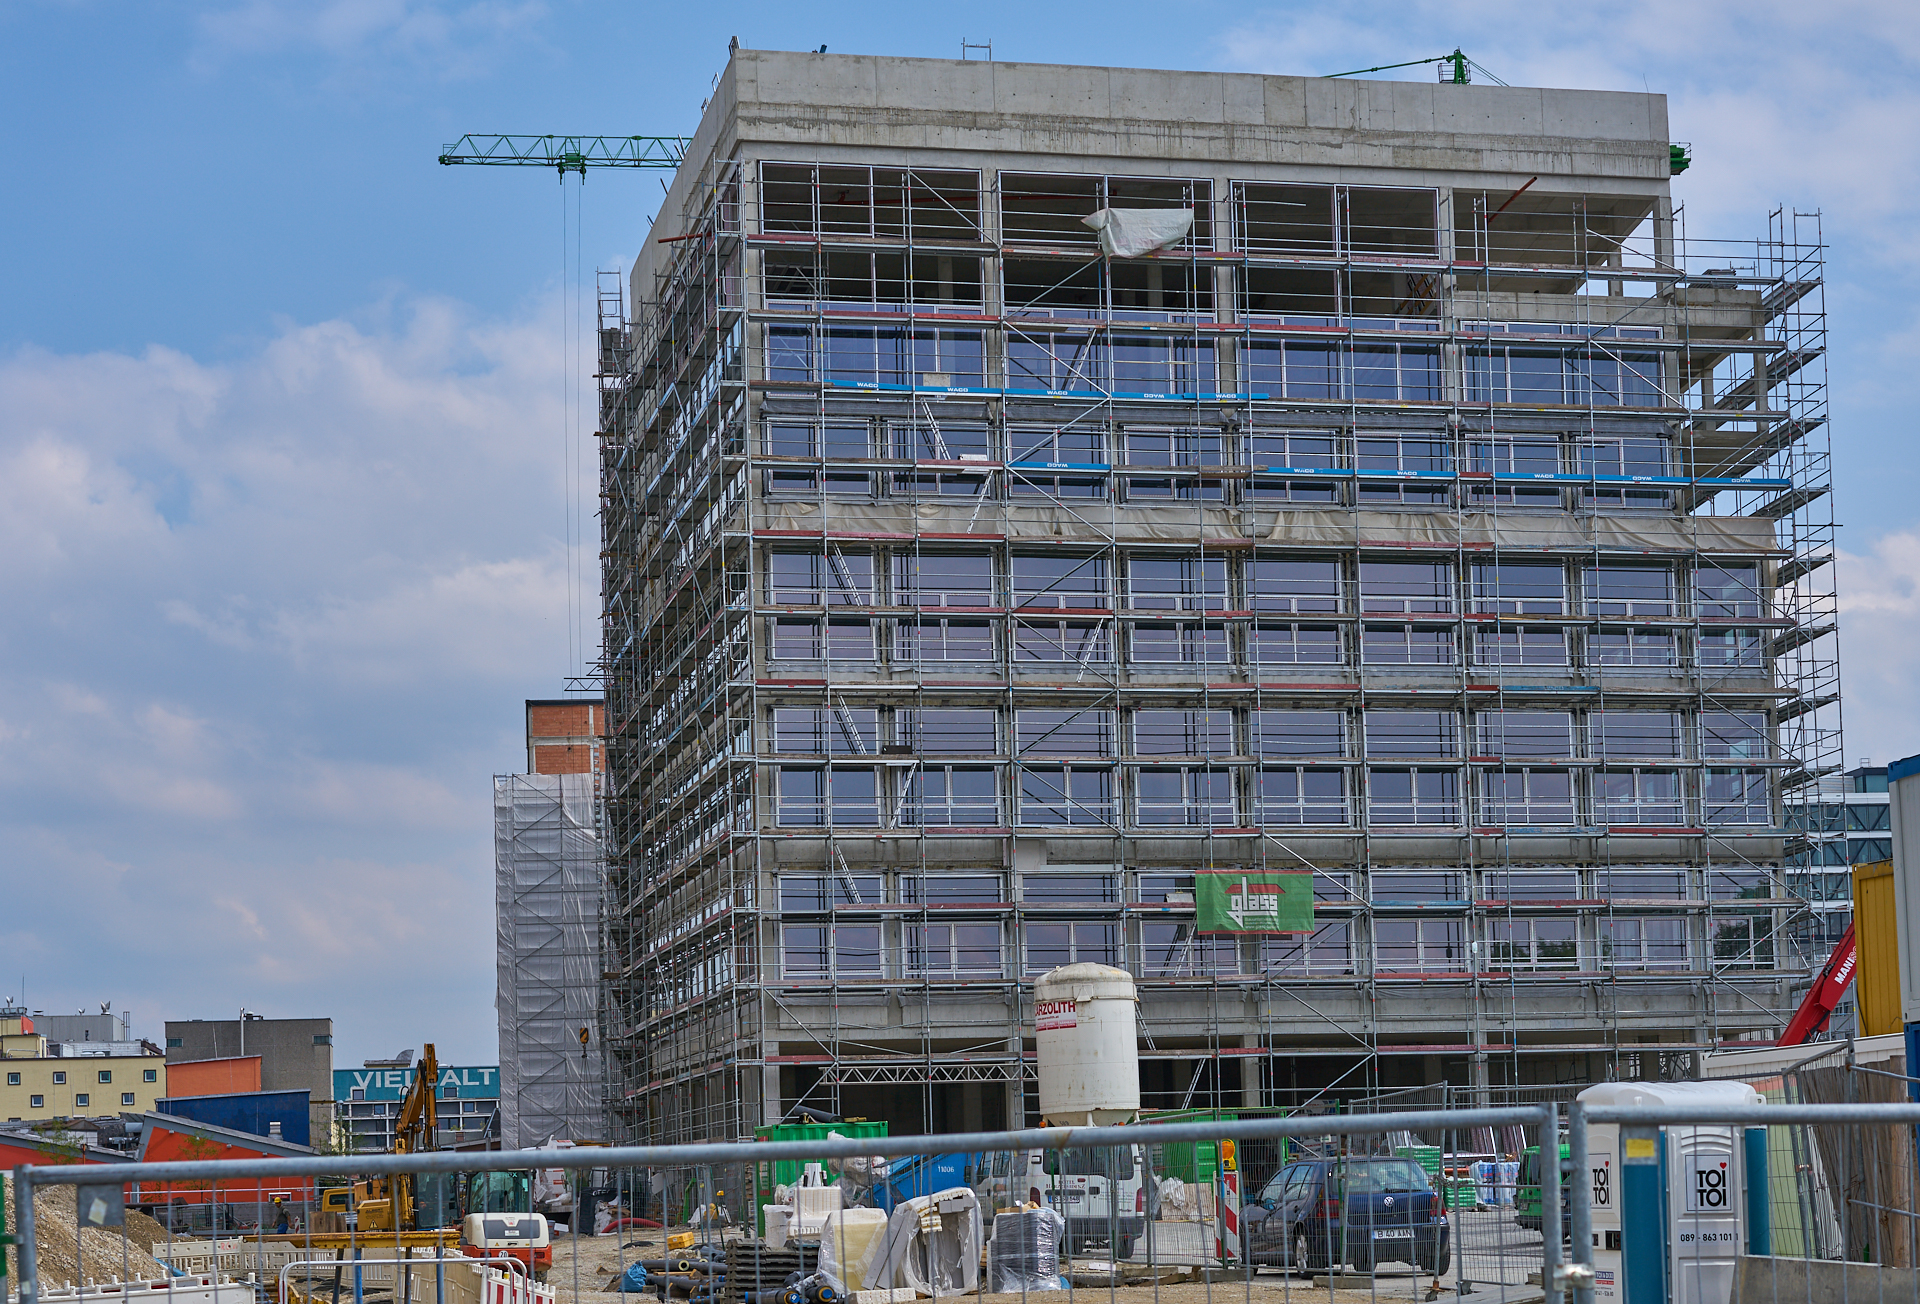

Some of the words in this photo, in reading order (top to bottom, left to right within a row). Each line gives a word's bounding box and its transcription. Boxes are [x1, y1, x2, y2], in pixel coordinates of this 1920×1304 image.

[1226, 876, 1278, 928] glass
[353, 1068, 496, 1088] VIELALT
[1592, 1168, 1609, 1187] TOI
[1697, 1169, 1726, 1188] TOI
[1593, 1187, 1610, 1205] TOI
[1697, 1188, 1727, 1207] TOI
[1680, 1233, 1695, 1242] 089
[1702, 1233, 1717, 1242] 863
